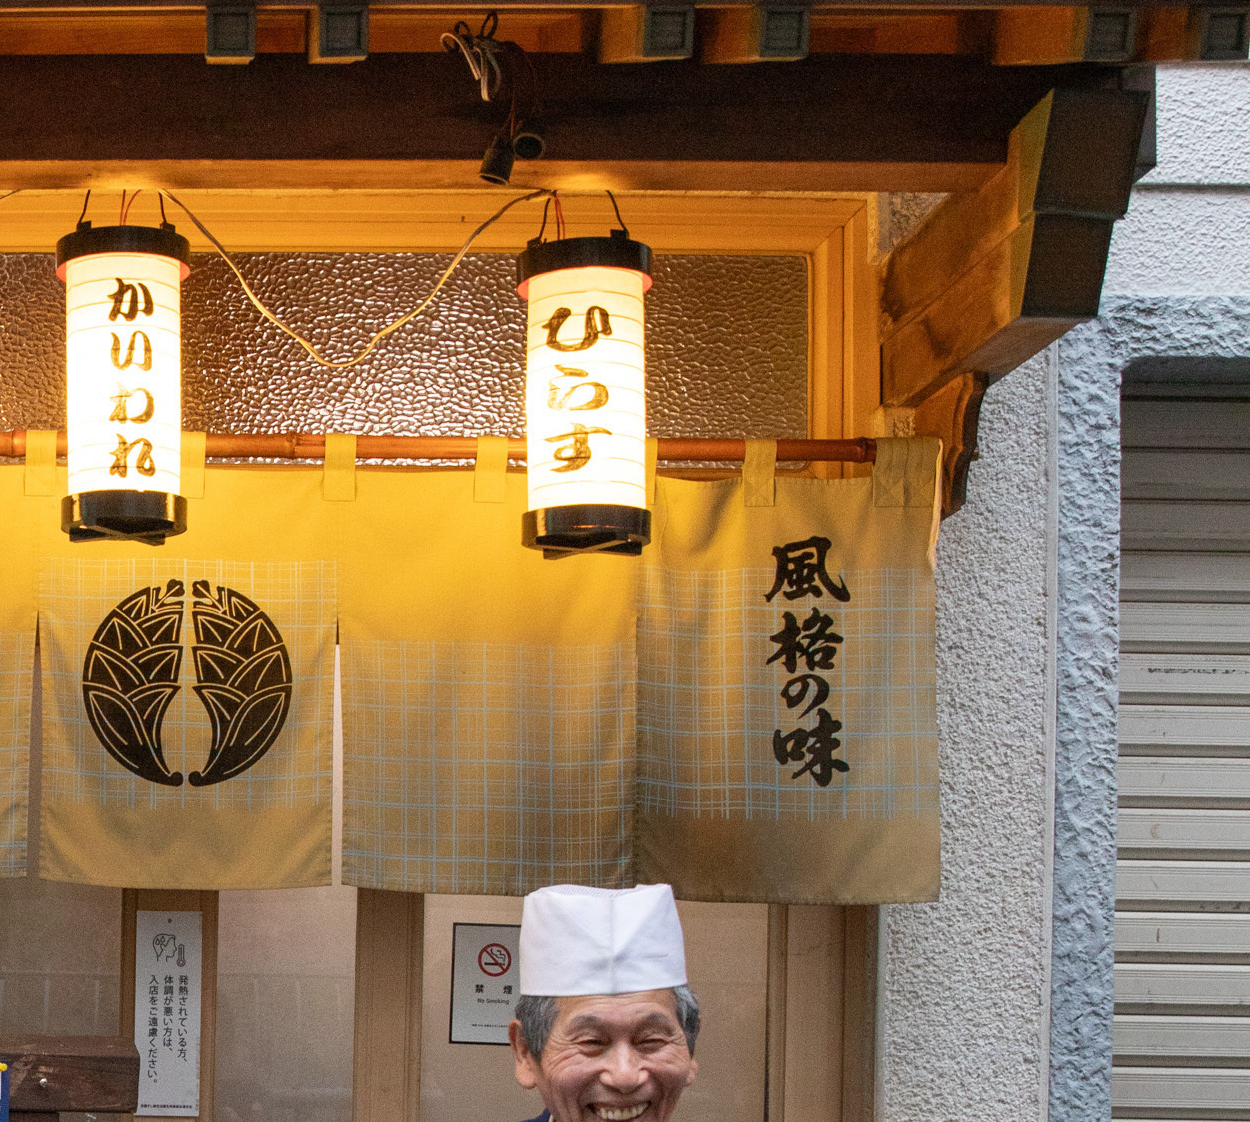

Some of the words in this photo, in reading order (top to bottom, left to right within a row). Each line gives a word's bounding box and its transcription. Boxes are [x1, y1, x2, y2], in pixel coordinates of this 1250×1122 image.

[107, 277, 156, 478] かいわれ
[542, 304, 612, 472] ひらす
[763, 535, 851, 788] 風格の味
[147, 975, 159, 1084] 入店をご遠慮ください。
[163, 975, 174, 1052] 体調が悪い方は、
[178, 975, 189, 1062] 発熱されている方、
[475, 984, 512, 994] 禁煙
